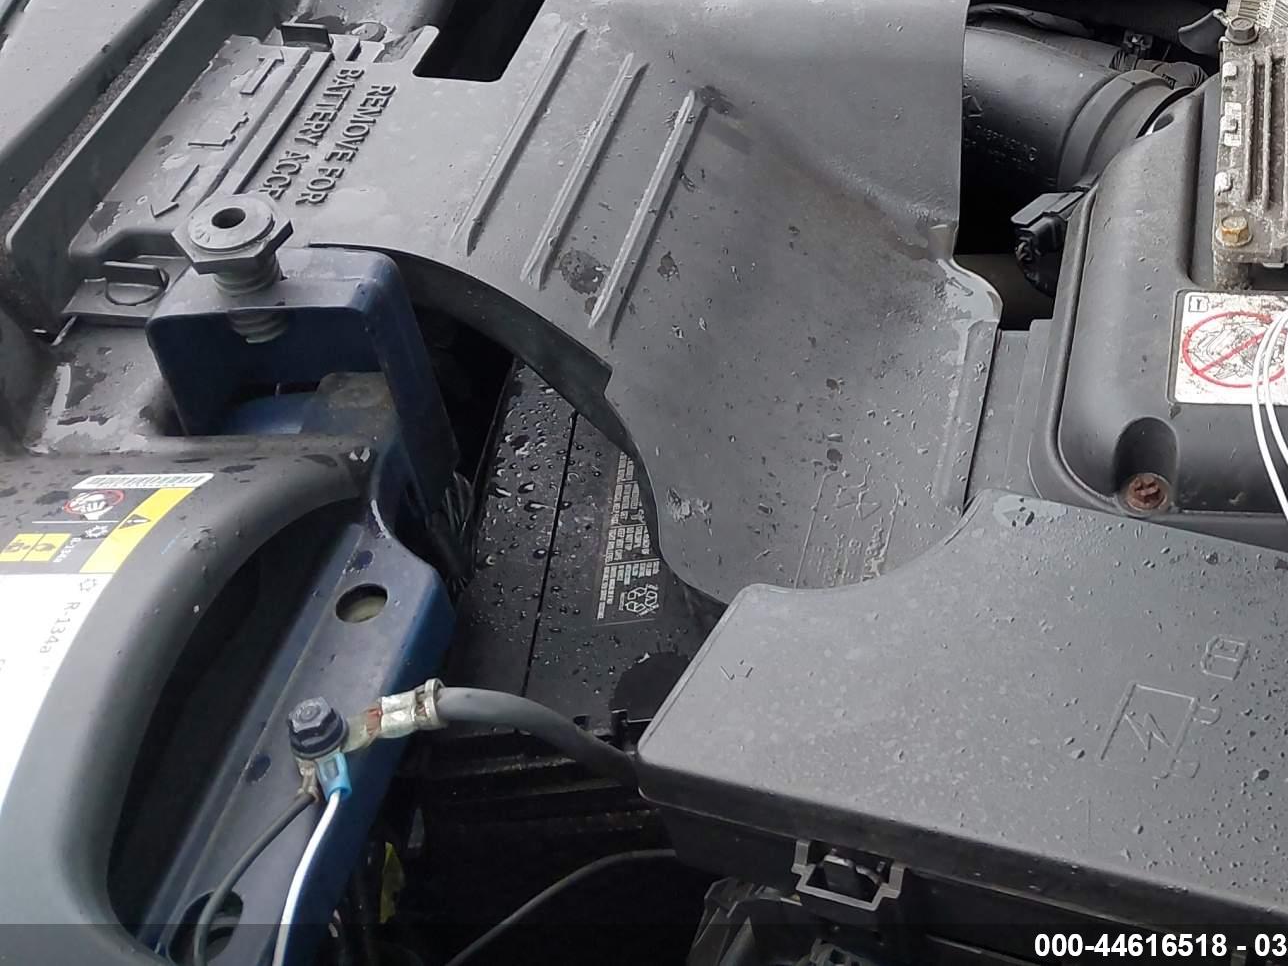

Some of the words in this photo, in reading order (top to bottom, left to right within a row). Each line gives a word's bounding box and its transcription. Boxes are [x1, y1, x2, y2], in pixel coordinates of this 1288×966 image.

[293, 65, 364, 147] BATTERY
[325, 83, 396, 164] REMOVE
[294, 165, 344, 207] FOR
